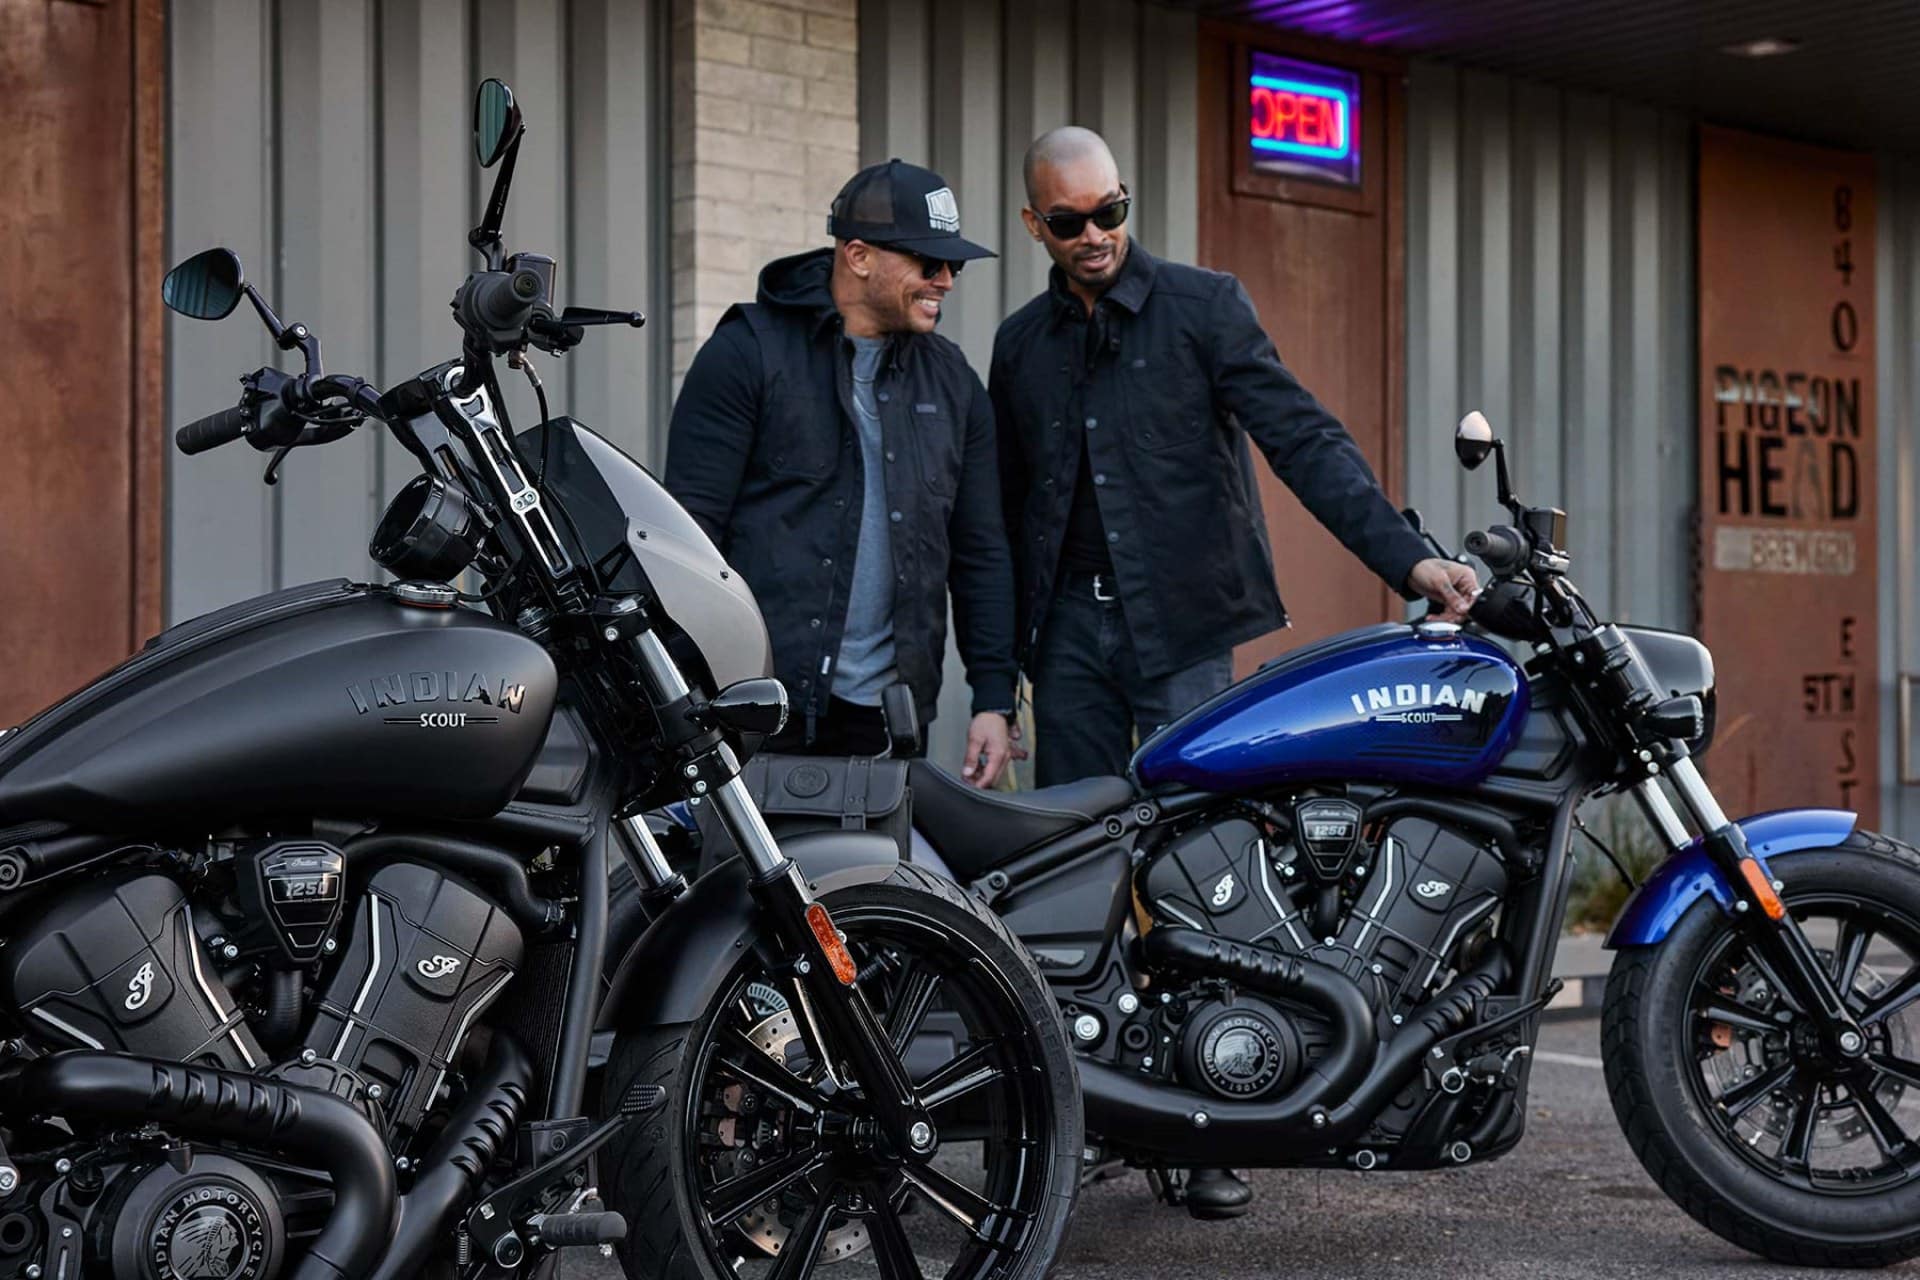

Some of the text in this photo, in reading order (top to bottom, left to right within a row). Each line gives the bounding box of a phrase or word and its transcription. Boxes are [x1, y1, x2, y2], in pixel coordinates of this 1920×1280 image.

[1250, 86, 1345, 149] OPEN
[1715, 365, 1860, 438] PIGEON
[1717, 430, 1859, 520] HEAD
[345, 671, 526, 714] INDIAN
[1351, 684, 1487, 714] INDIAN
[1803, 674, 1856, 714] 5TH
[420, 713, 466, 727] SCOUT
[1401, 712, 1436, 724] SCOUT
[1314, 825, 1346, 836] 1250
[286, 880, 329, 897] 1250
[1223, 1018, 1279, 1077] MOTORCYCLE
[155, 1187, 264, 1280] NDIAN MOTORCYCLE
